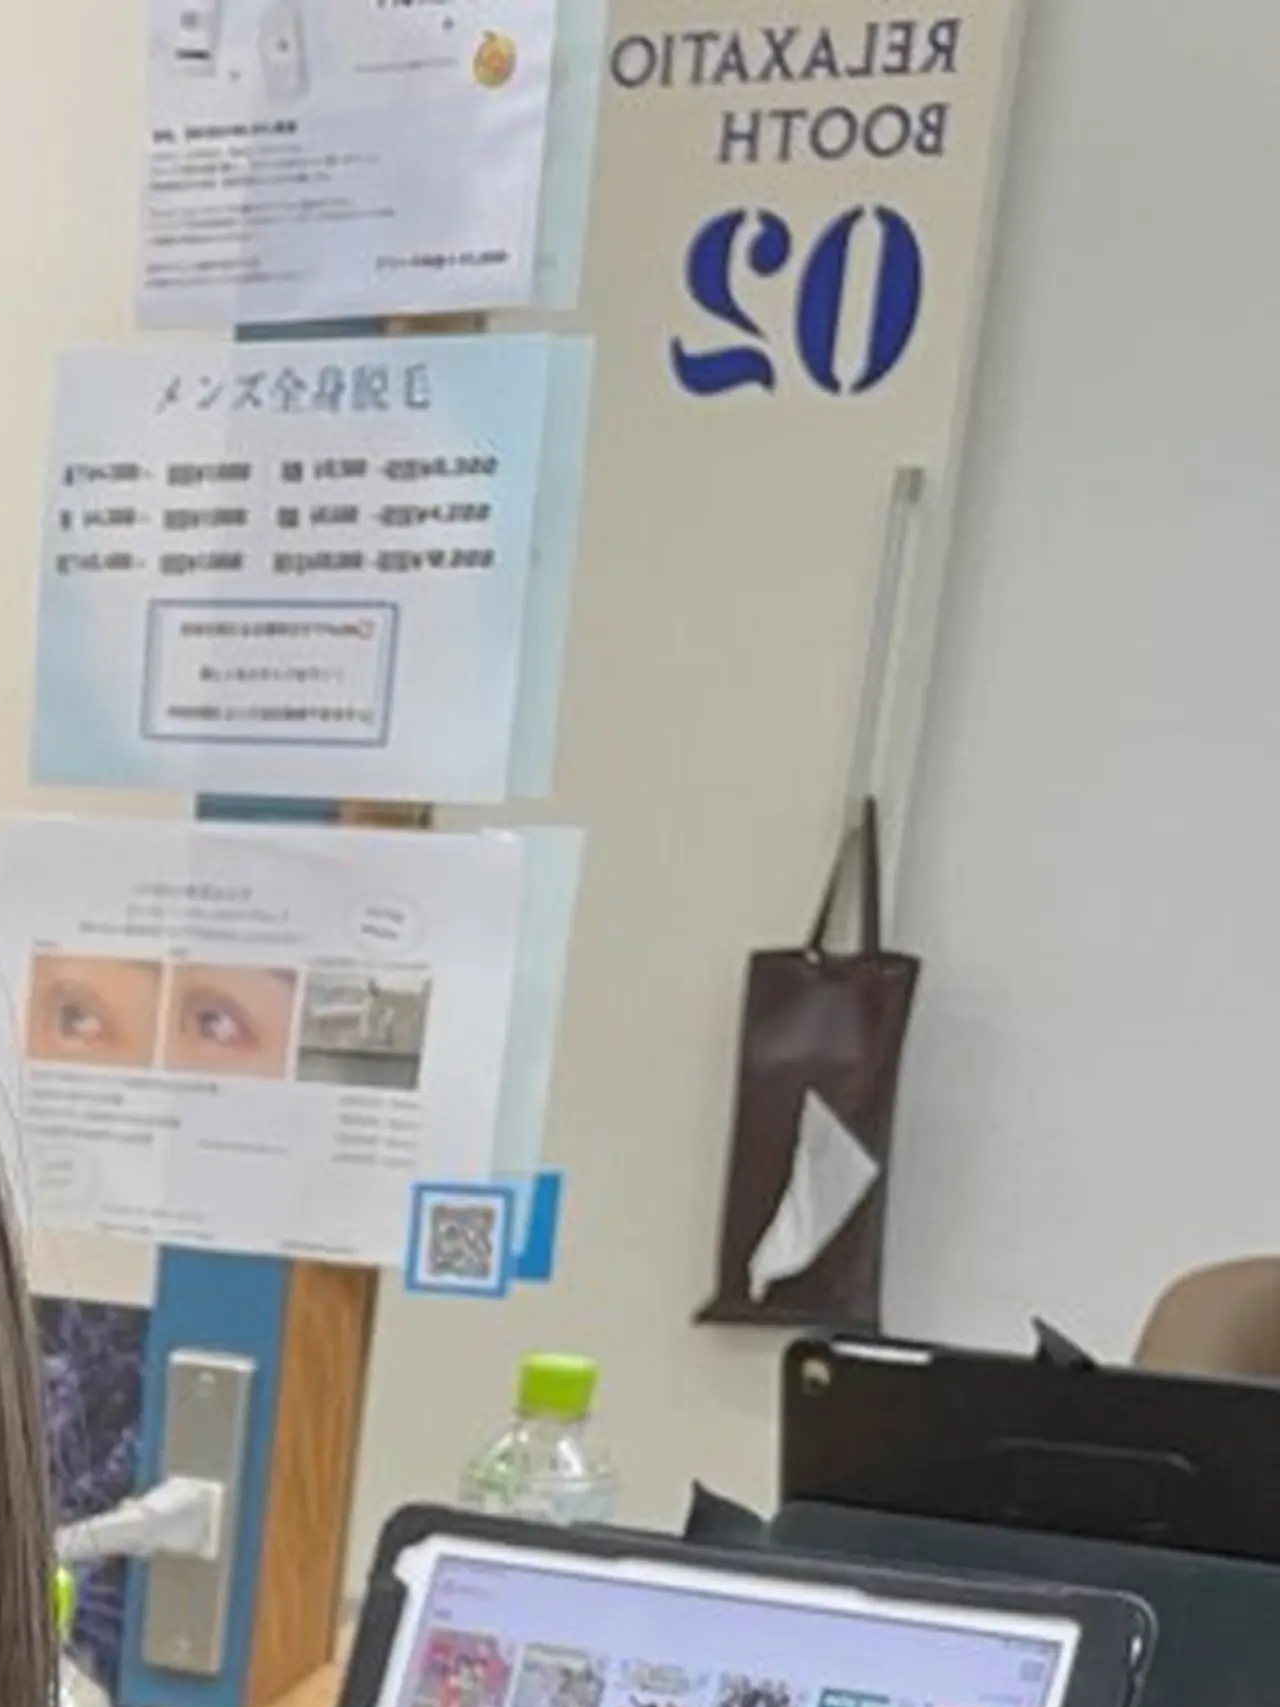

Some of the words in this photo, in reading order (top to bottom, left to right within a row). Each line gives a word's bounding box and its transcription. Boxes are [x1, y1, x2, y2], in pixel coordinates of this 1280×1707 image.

[154, 362, 432, 414] メンズ全身脱毛
